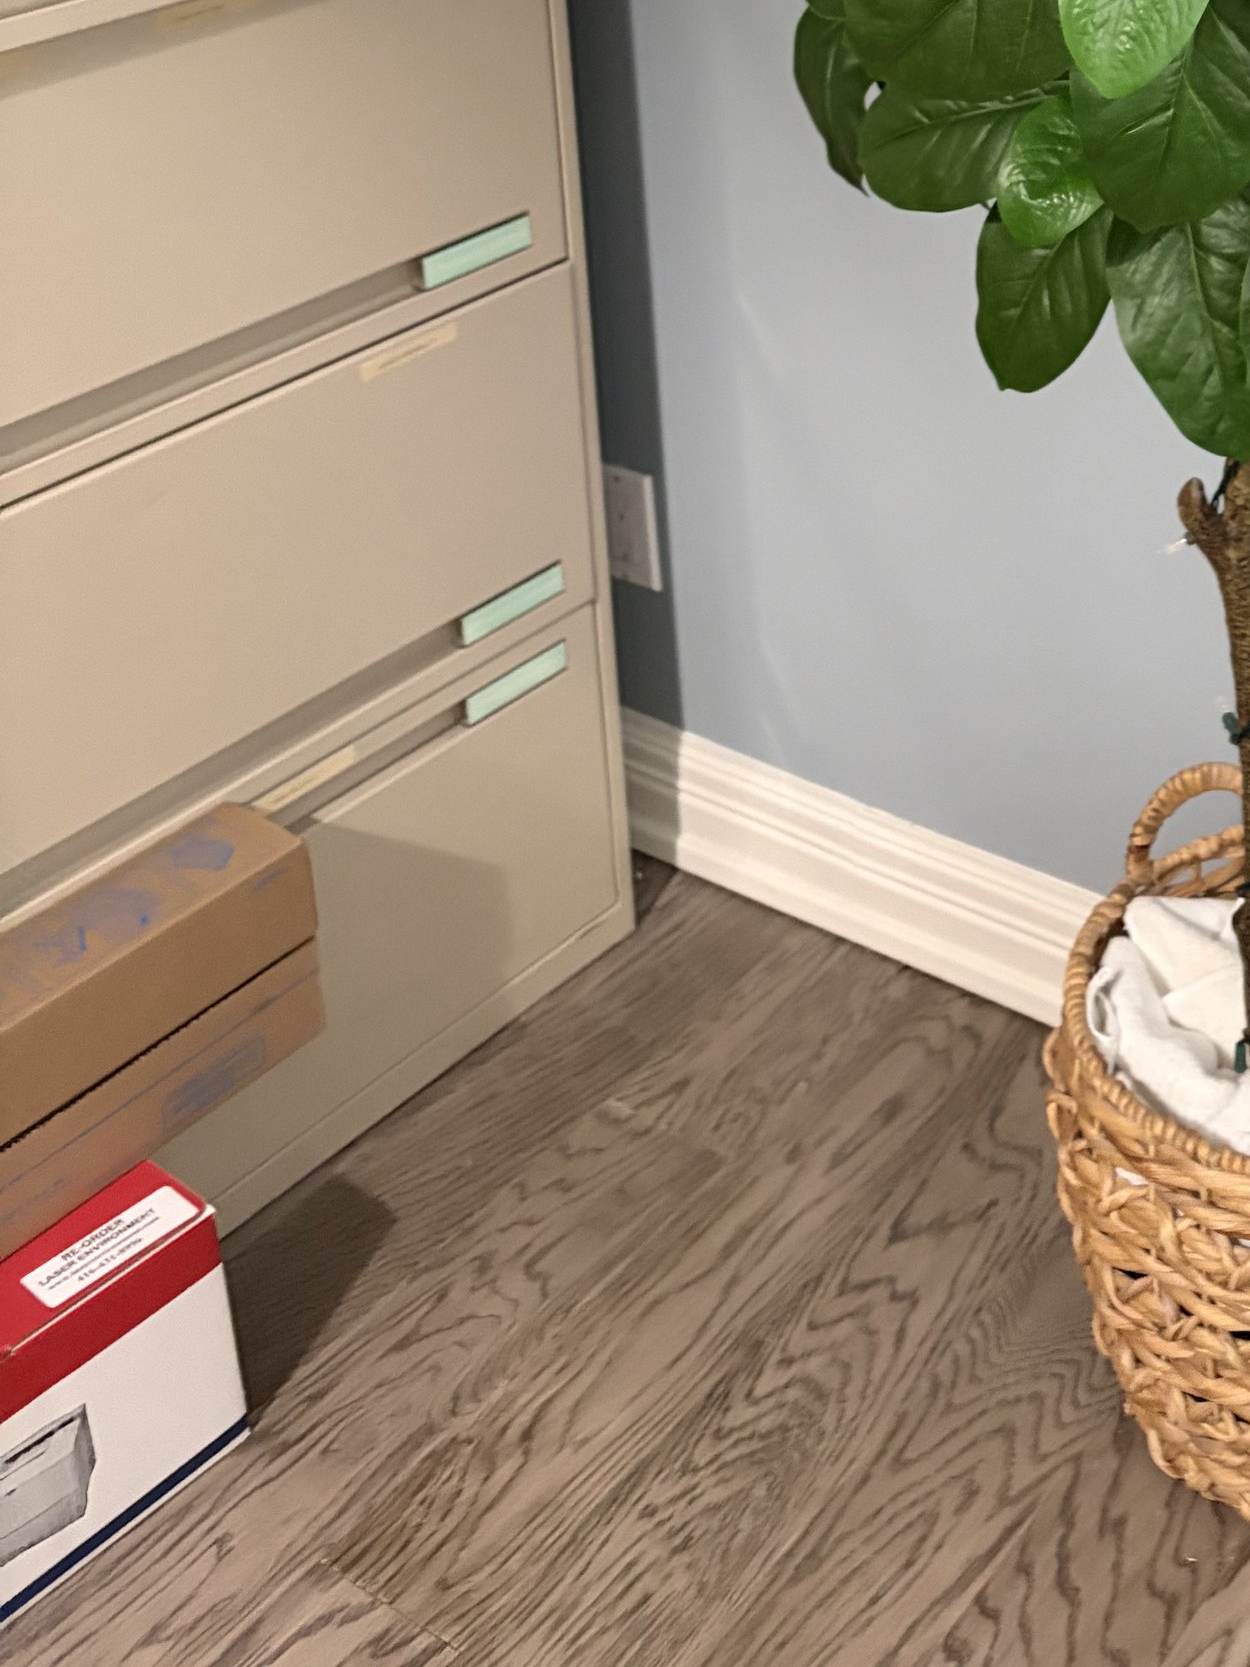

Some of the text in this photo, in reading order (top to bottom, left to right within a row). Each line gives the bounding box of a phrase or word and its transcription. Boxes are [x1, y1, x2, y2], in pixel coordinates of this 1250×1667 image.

[38, 1259, 79, 1287] LASER
[77, 1208, 156, 1262] ENVIRONMENT
[61, 1218, 127, 1261] RE-ORDER
